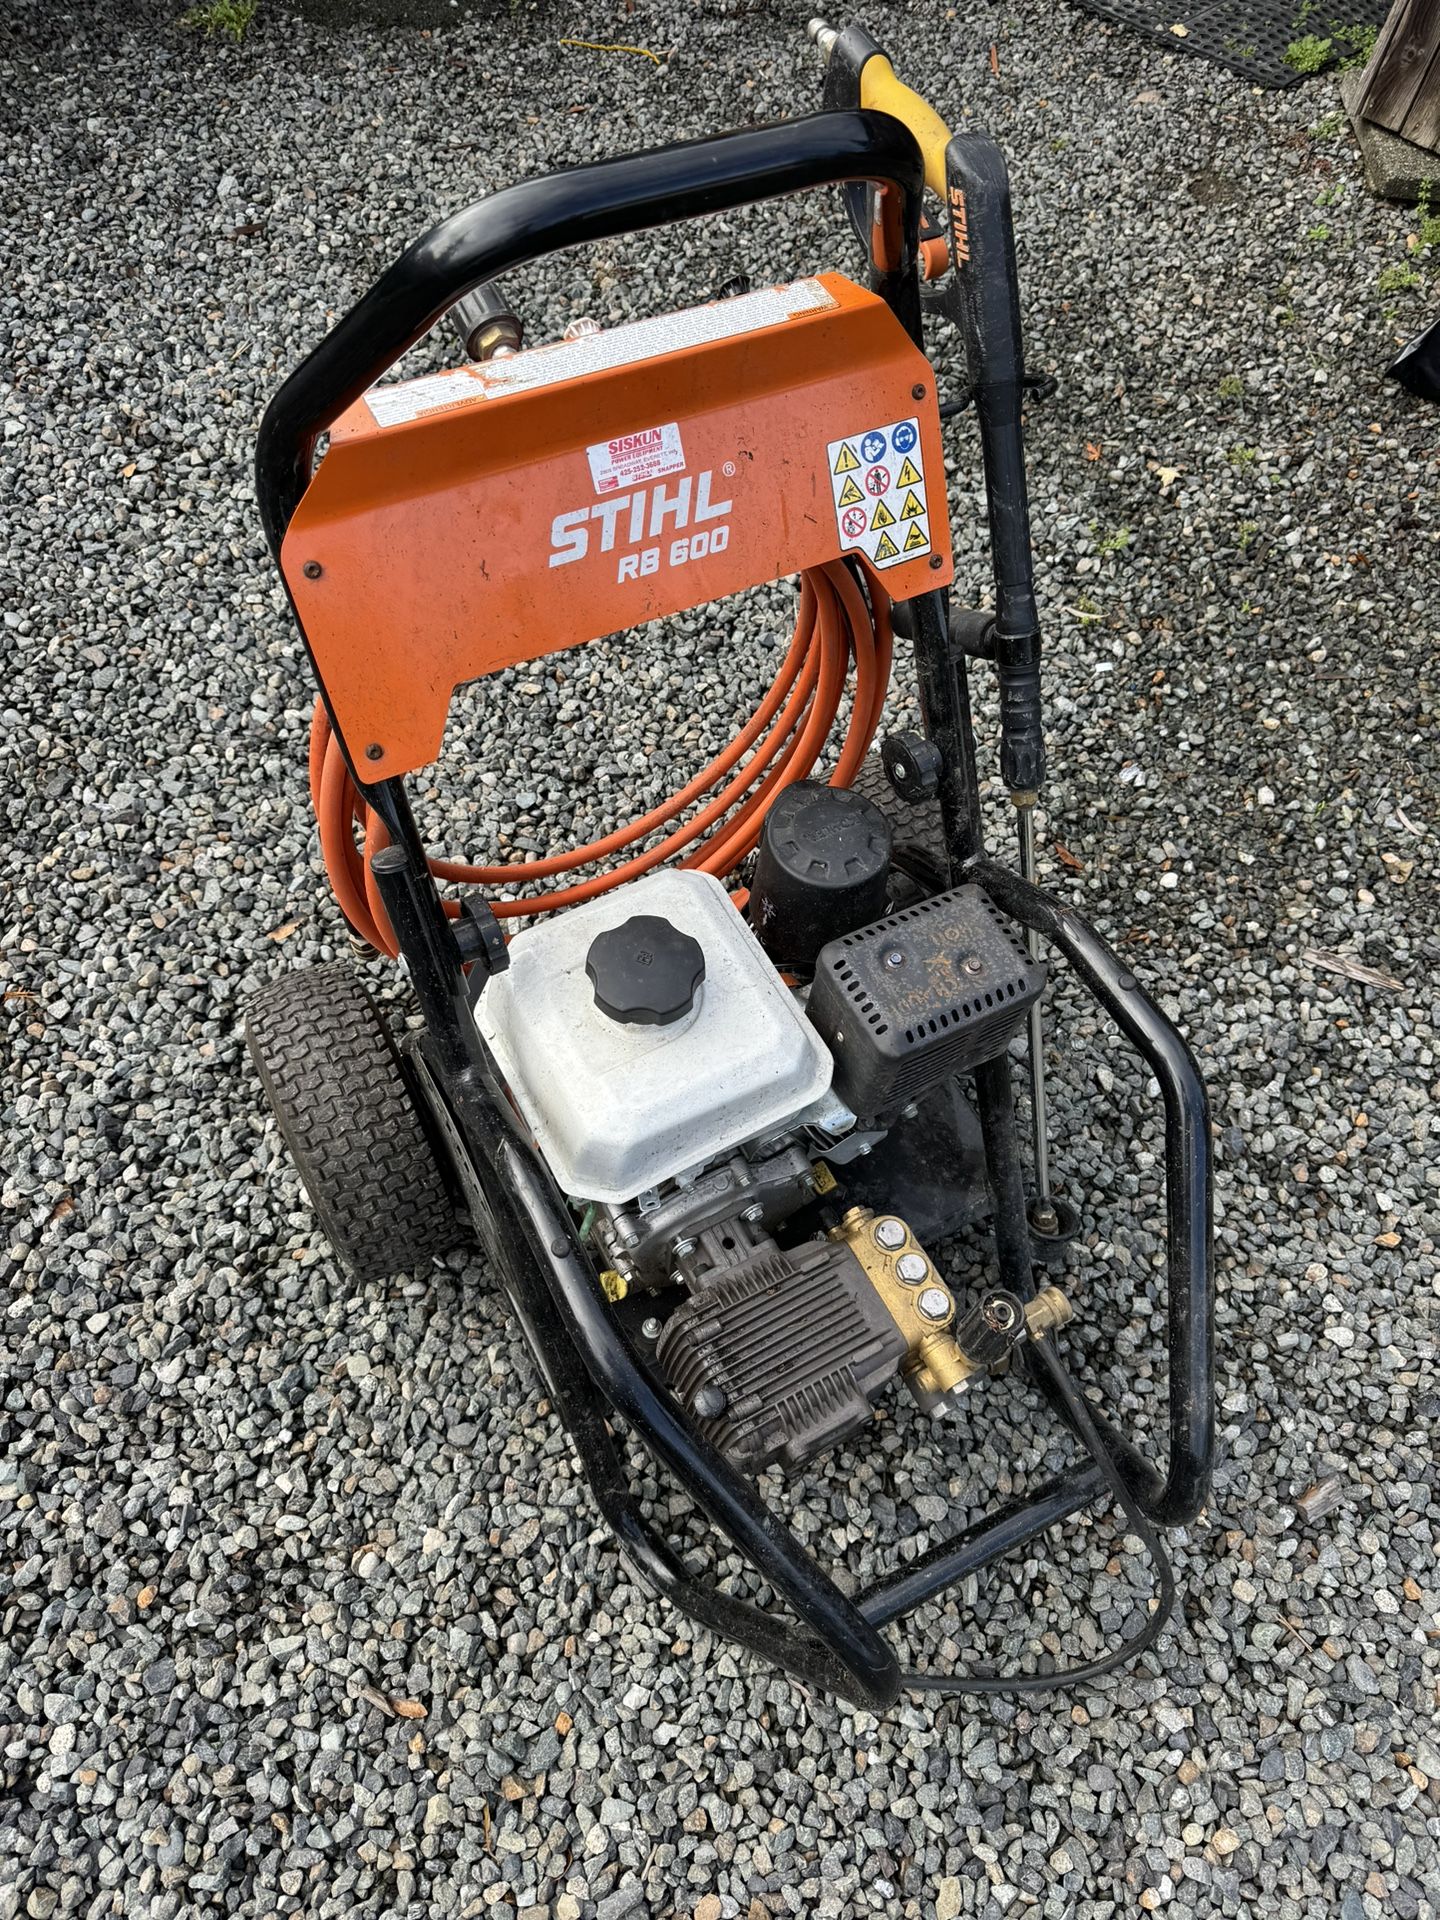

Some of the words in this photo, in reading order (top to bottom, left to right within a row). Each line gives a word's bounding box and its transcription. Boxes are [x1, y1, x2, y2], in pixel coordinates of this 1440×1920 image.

[950, 186, 971, 268] STIHL
[608, 428, 662, 454] SISKUN
[611, 455, 631, 465] POWER
[632, 446, 663, 460] EQUIPMENT
[658, 462, 684, 473] SNAPPER
[549, 470, 733, 569] STIHL
[617, 547, 660, 584] RB
[669, 525, 730, 567] 600
